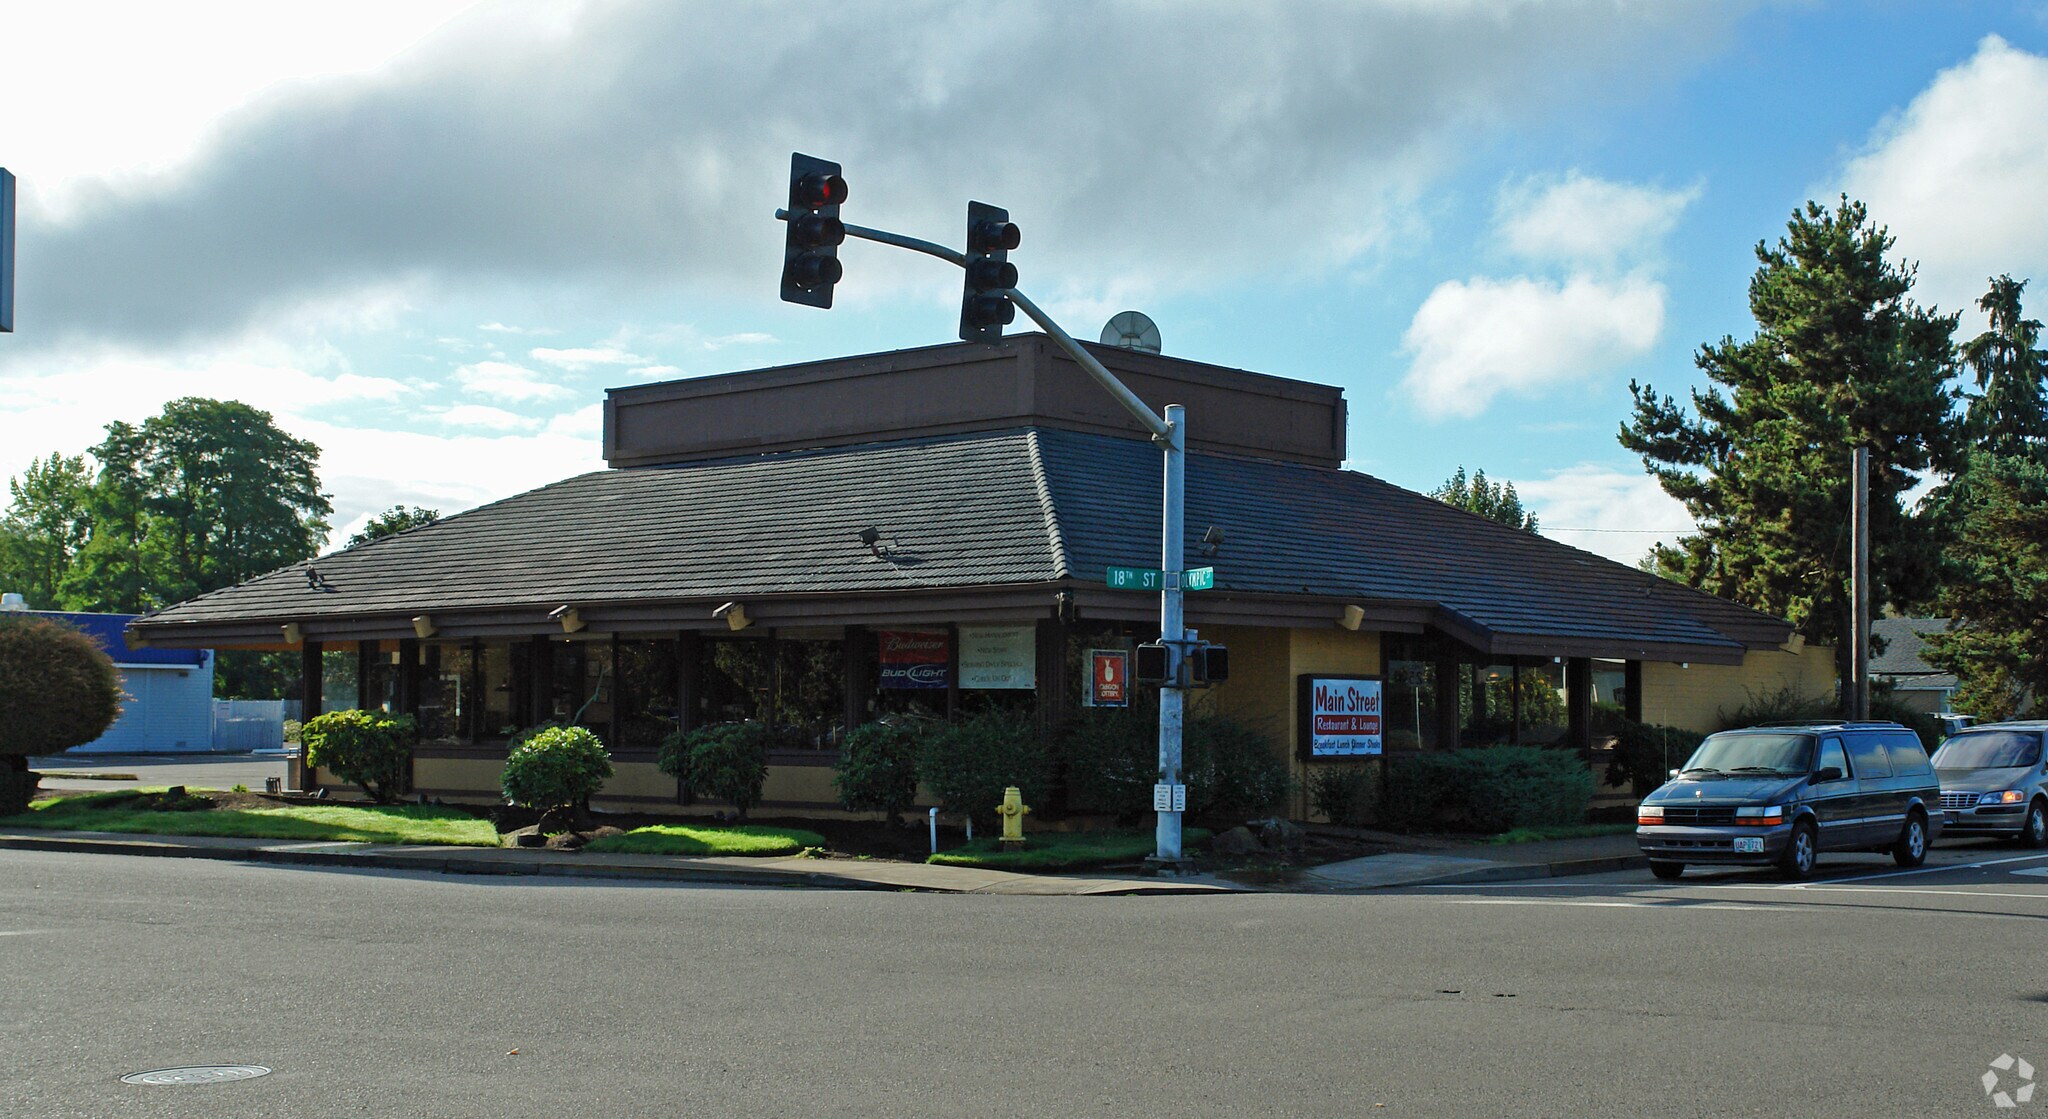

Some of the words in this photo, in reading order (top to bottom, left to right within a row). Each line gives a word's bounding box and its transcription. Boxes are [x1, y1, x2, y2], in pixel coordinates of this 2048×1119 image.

[1113, 569, 1133, 586] 18TH
[1142, 572, 1156, 588] ST
[1180, 571, 1206, 588] OLYMPIC
[887, 637, 944, 651] Budweiser
[882, 669, 906, 677] BUD
[911, 669, 947, 677] LIGHT
[1315, 684, 1345, 712] Main
[1347, 686, 1379, 712] Street
[1317, 716, 1349, 731] Restaurant
[1351, 716, 1357, 731] &
[1360, 717, 1378, 734] Lounge
